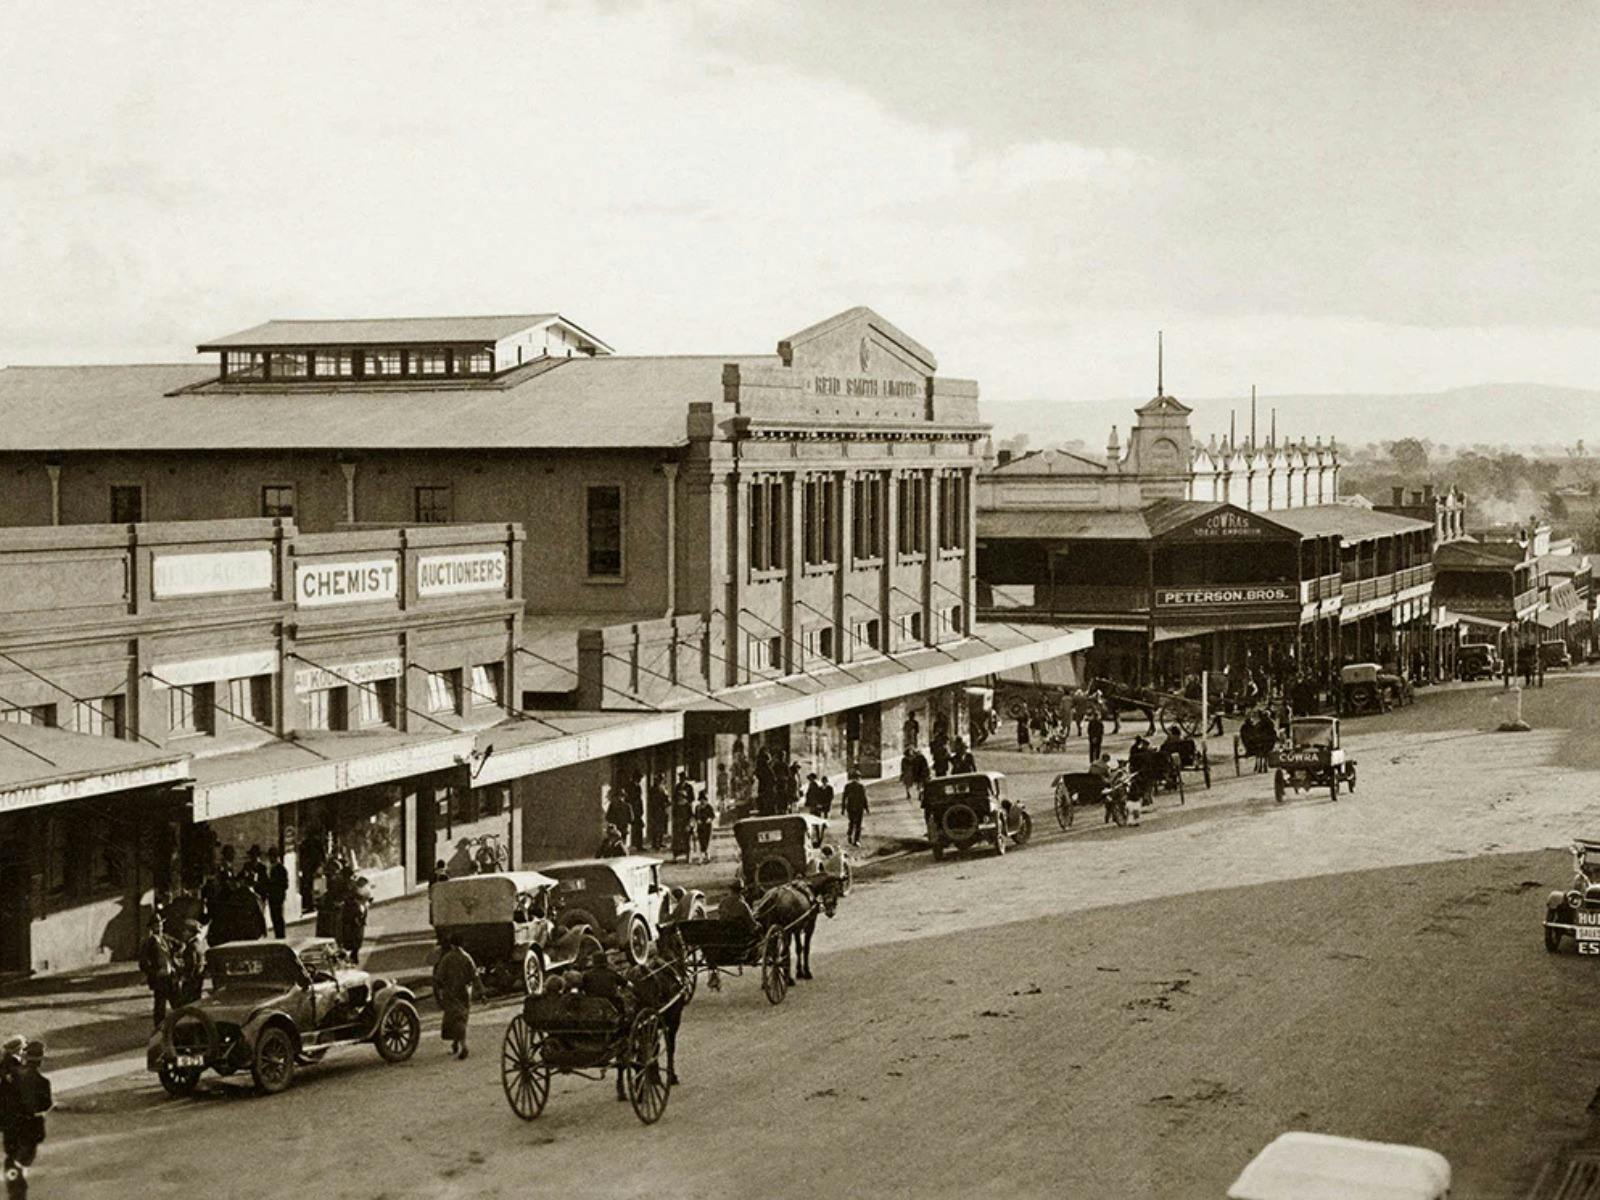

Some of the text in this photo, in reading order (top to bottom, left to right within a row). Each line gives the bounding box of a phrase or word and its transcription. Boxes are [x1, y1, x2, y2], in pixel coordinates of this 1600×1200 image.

[303, 566, 393, 598] CHEMIST
[421, 558, 504, 588] AUCTIONEERS
[1279, 752, 1320, 763] COWRA
